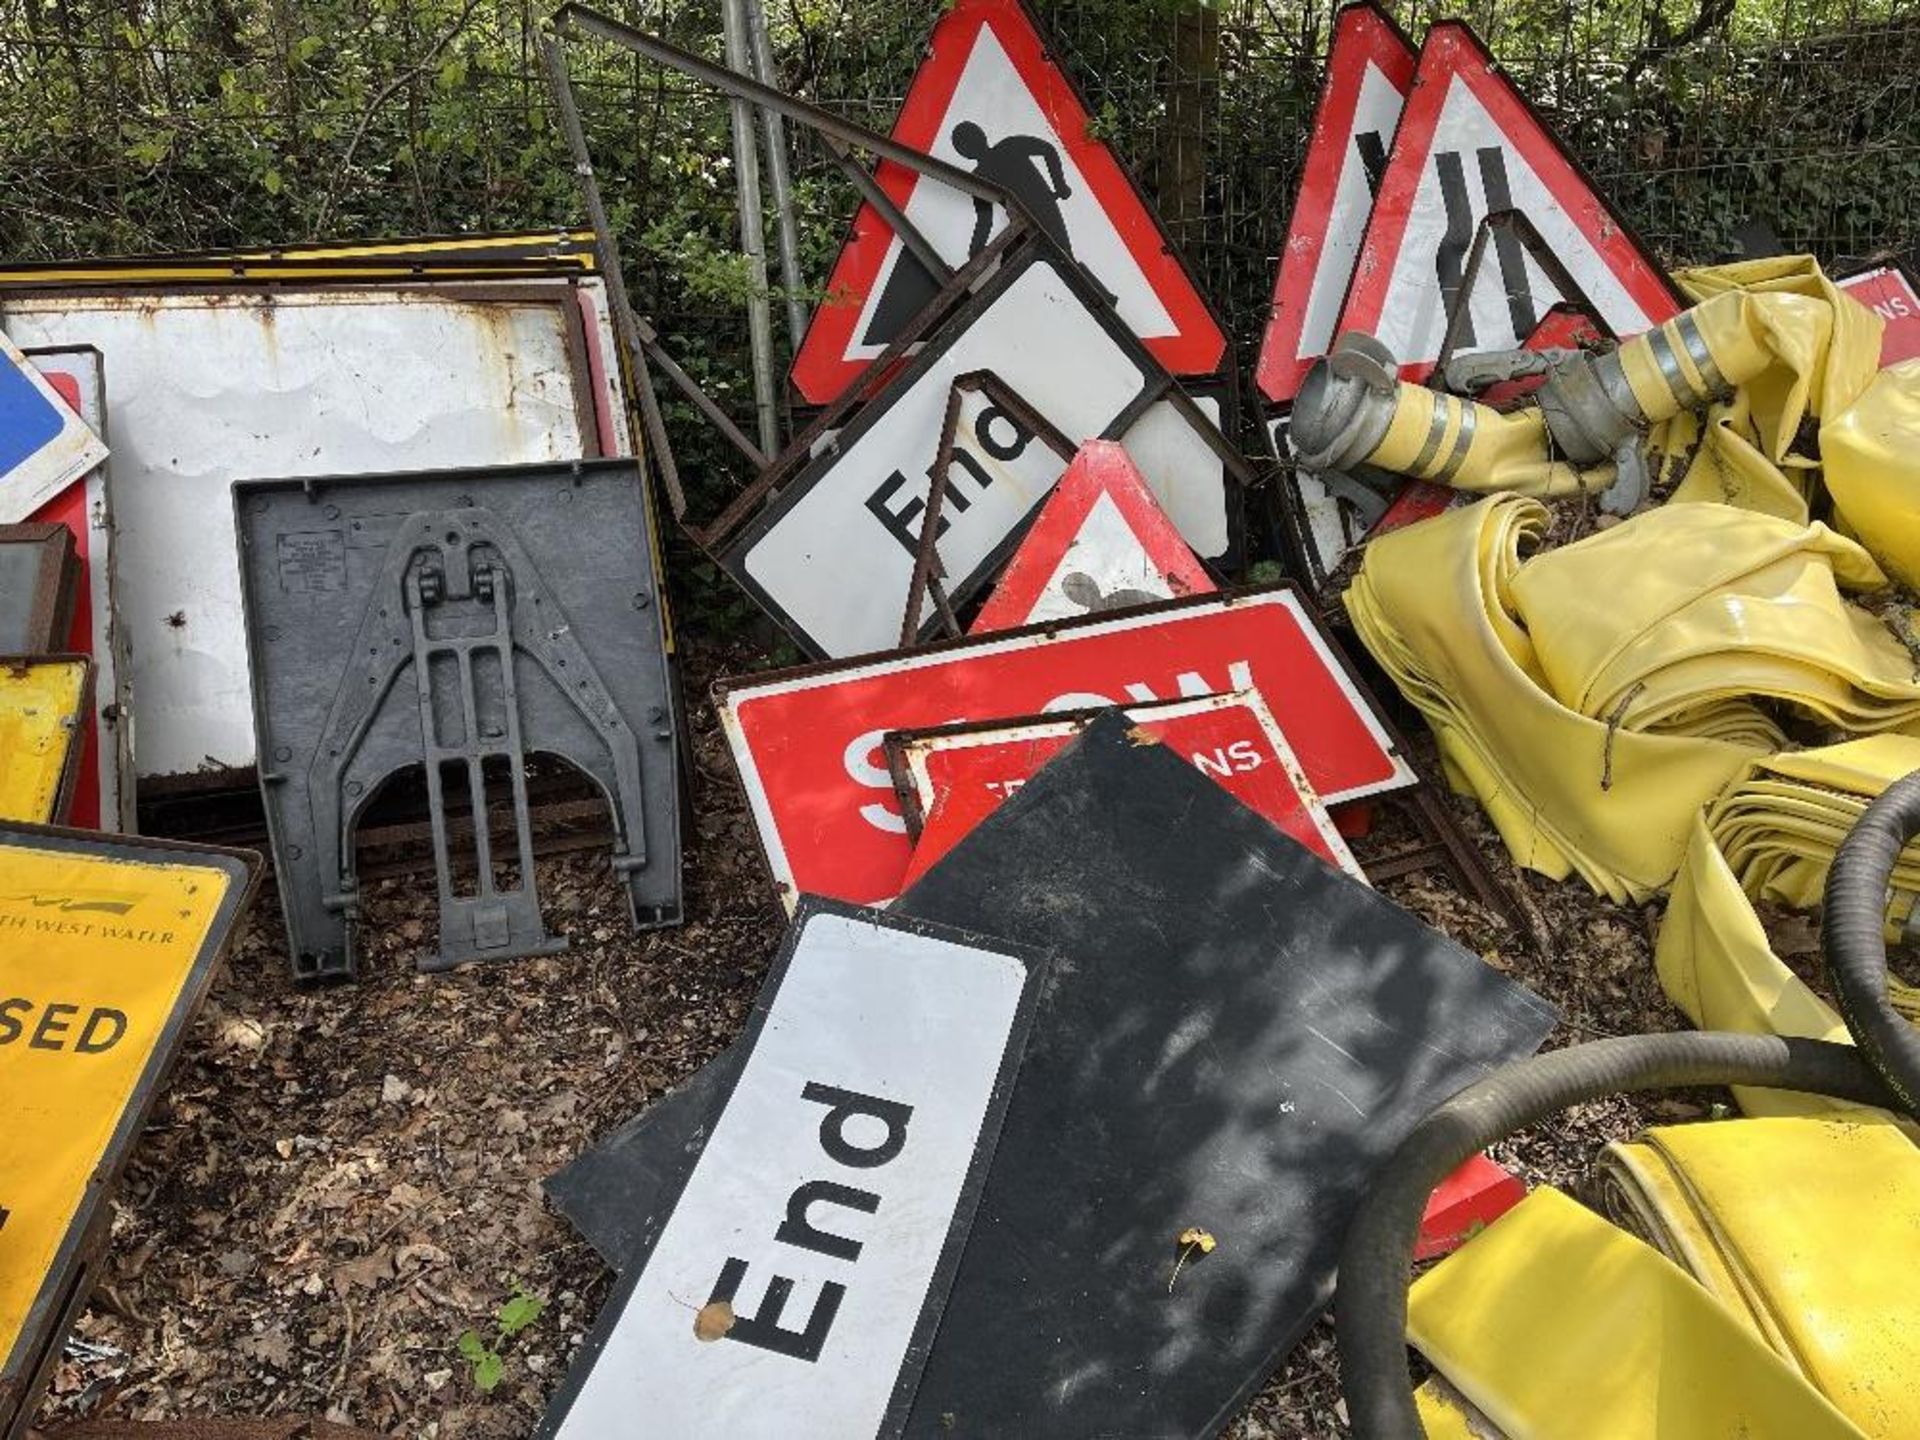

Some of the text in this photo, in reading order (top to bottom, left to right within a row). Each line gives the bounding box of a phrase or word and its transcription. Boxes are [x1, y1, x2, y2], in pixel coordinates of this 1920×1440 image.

[864, 405, 1039, 560] End
[35, 919, 95, 937] WEST
[102, 926, 175, 944] WATER
[699, 1080, 915, 1363] End
